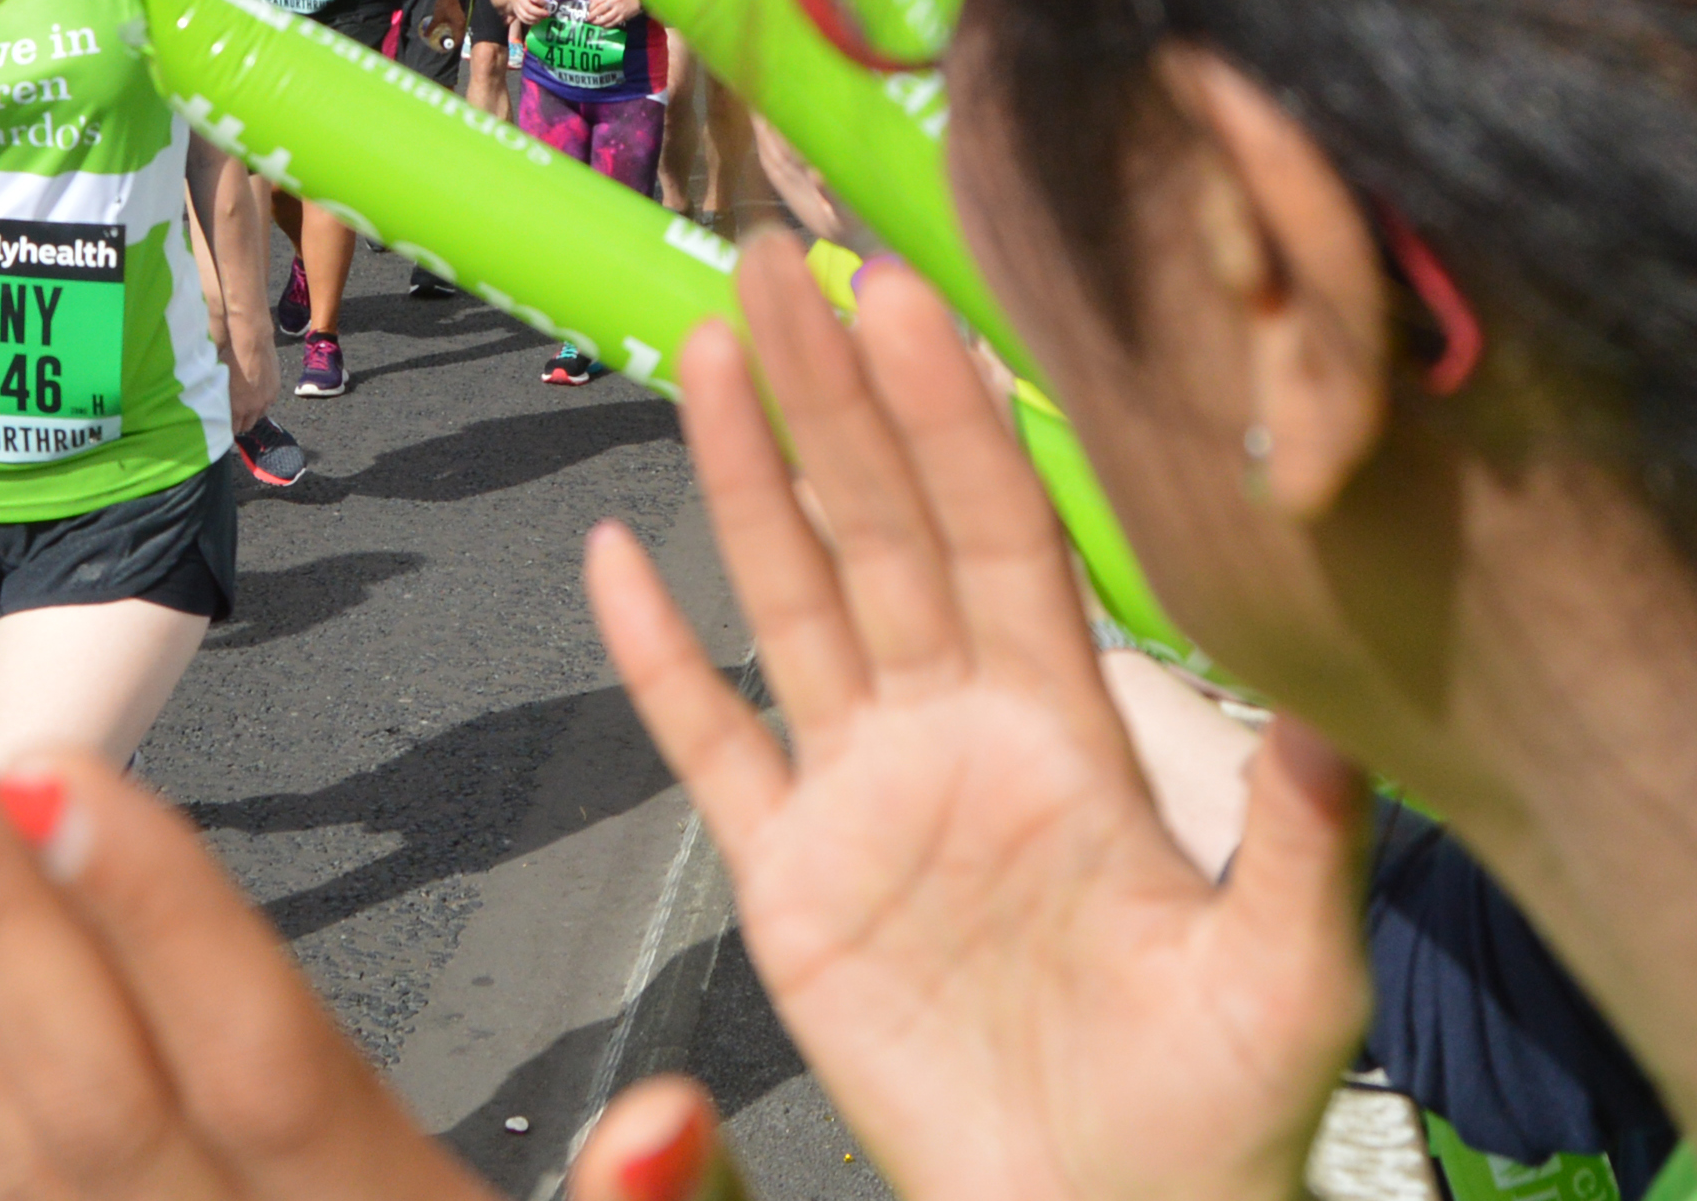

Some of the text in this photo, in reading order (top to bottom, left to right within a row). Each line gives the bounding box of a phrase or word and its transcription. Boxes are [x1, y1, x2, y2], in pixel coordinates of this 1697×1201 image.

[48, 23, 102, 60] in
[544, 45, 603, 73] 41100
[92, 394, 104, 416] H
